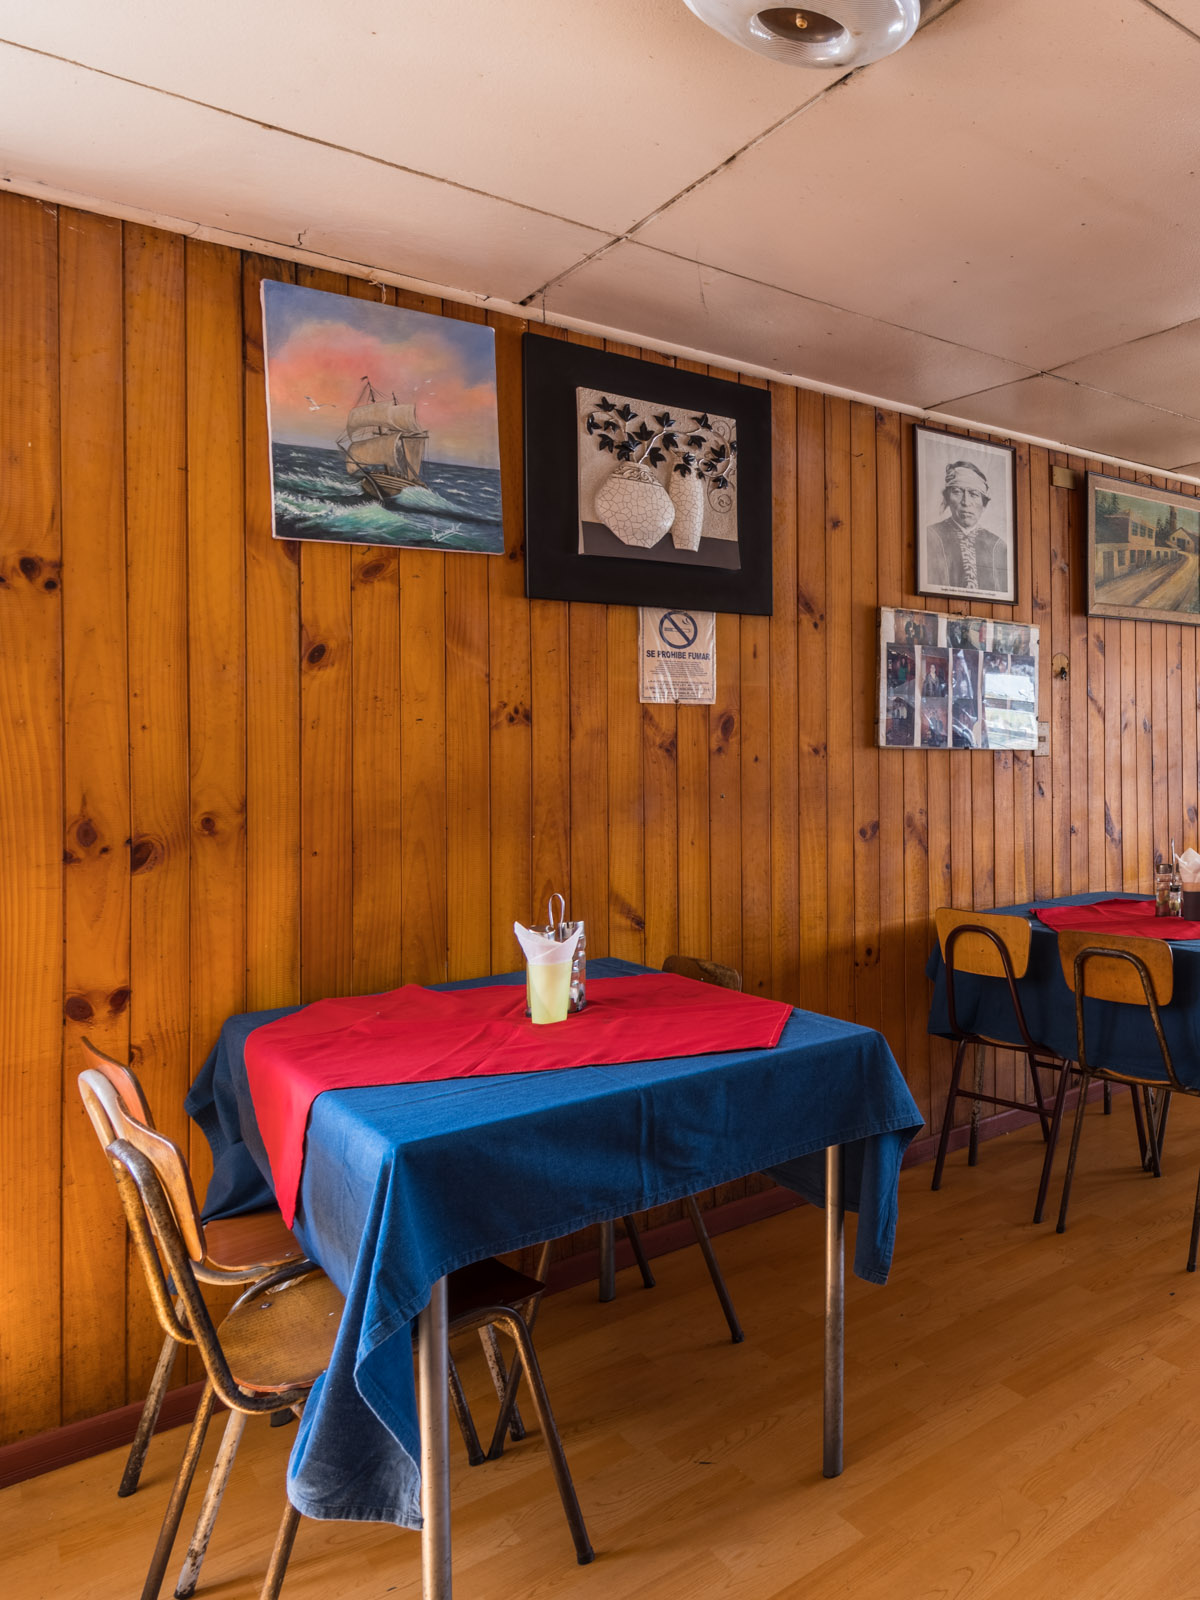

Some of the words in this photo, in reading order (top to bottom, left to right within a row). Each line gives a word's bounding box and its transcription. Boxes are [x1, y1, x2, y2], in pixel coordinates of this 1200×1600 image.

[646, 650, 656, 658] SE
[657, 651, 687, 659] PROHIBE
[688, 652, 711, 660] FUMAR
